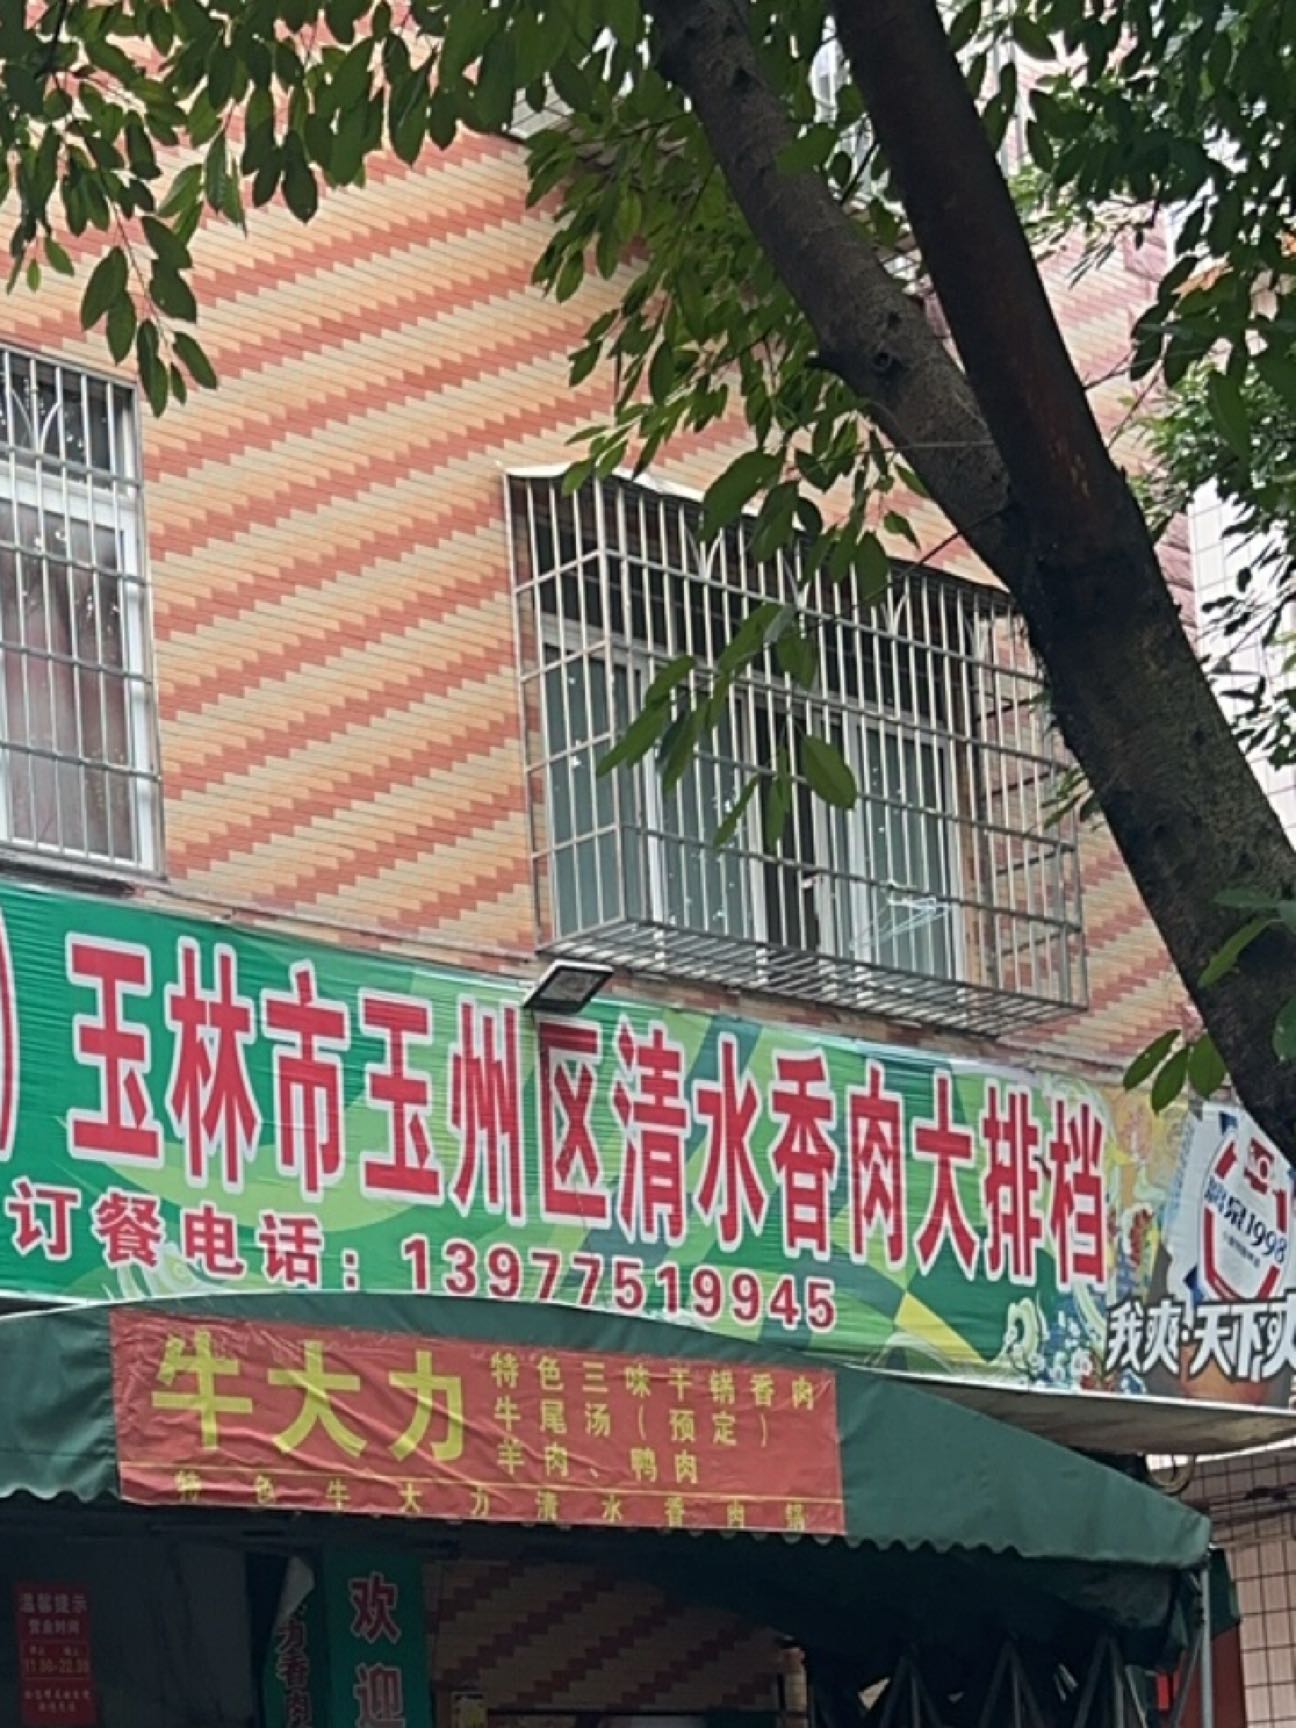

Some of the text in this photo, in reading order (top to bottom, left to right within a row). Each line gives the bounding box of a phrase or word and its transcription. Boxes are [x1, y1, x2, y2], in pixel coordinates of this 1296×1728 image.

[152, 1331, 467, 1463] 牛大力
[489, 1351, 815, 1412] 特色三味干锅香肉
[496, 1437, 699, 1485] 羊肉、鸭肉
[173, 1470, 808, 1530] 特色牛大力清水香肉锅
